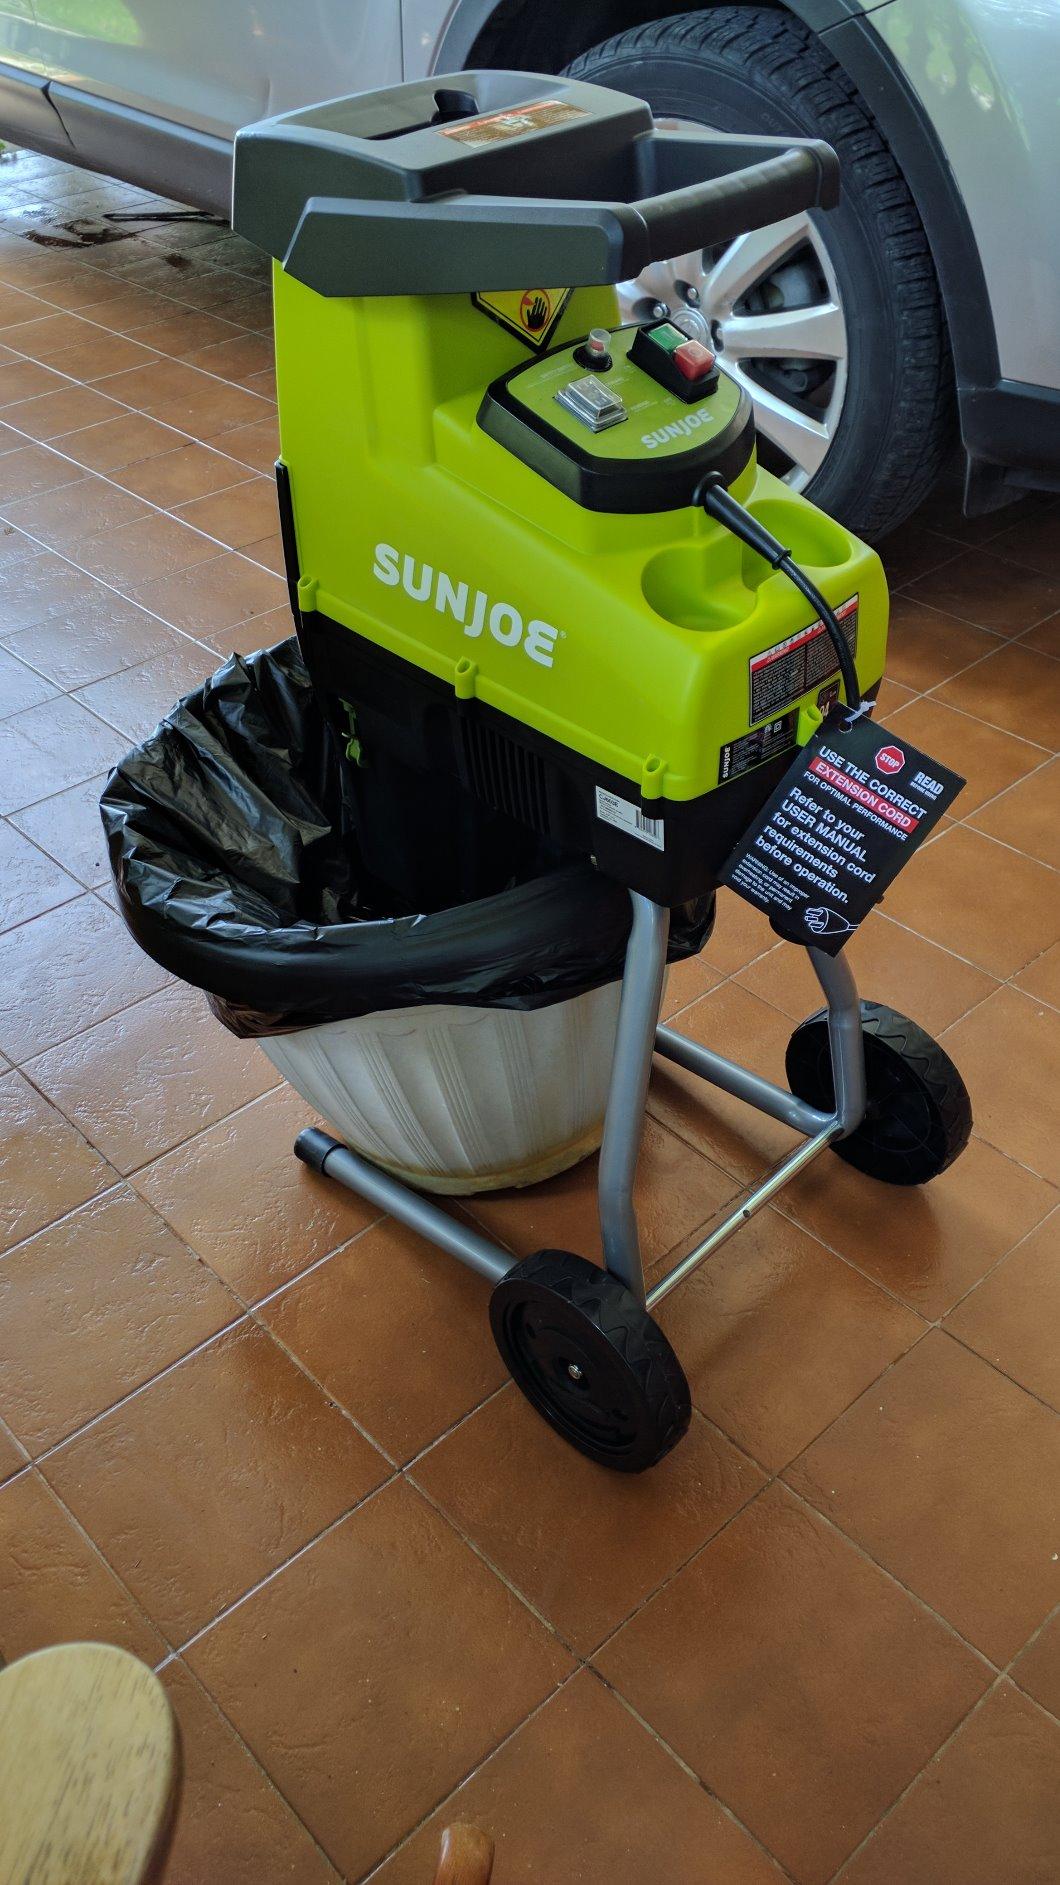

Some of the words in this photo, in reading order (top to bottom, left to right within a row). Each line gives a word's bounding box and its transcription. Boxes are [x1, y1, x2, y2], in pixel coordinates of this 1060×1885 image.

[641, 408, 714, 449] SUNJOE
[373, 543, 560, 668] SUNJOE
[722, 746, 731, 779] SUNJOE
[818, 746, 846, 768] USE
[845, 762, 870, 784] THE
[869, 779, 928, 820] CORRECT
[880, 753, 900, 768] STOP
[914, 771, 944, 795] READ
[790, 786, 823, 814] Refer
[822, 809, 836, 822] to
[834, 820, 866, 840] your
[803, 770, 821, 786] FOR
[820, 781, 852, 806] OPTIMAL
[852, 802, 909, 842] PERFORMANCE
[815, 762, 878, 808] EXTENSION
[878, 802, 912, 828] CORD
[764, 826, 838, 878] requirements
[772, 812, 791, 828] for
[790, 826, 846, 866] extension
[846, 862, 876, 884] cord
[782, 800, 816, 828] USER
[815, 822, 866, 862] MANUAL
[732, 874, 742, 882] void
[740, 881, 752, 890] your
[756, 835, 792, 866] before
[793, 864, 848, 904] operation.
[762, 873, 774, 882] cord
[772, 880, 782, 889] may
[782, 886, 796, 897] result
[768, 870, 778, 878] Use
